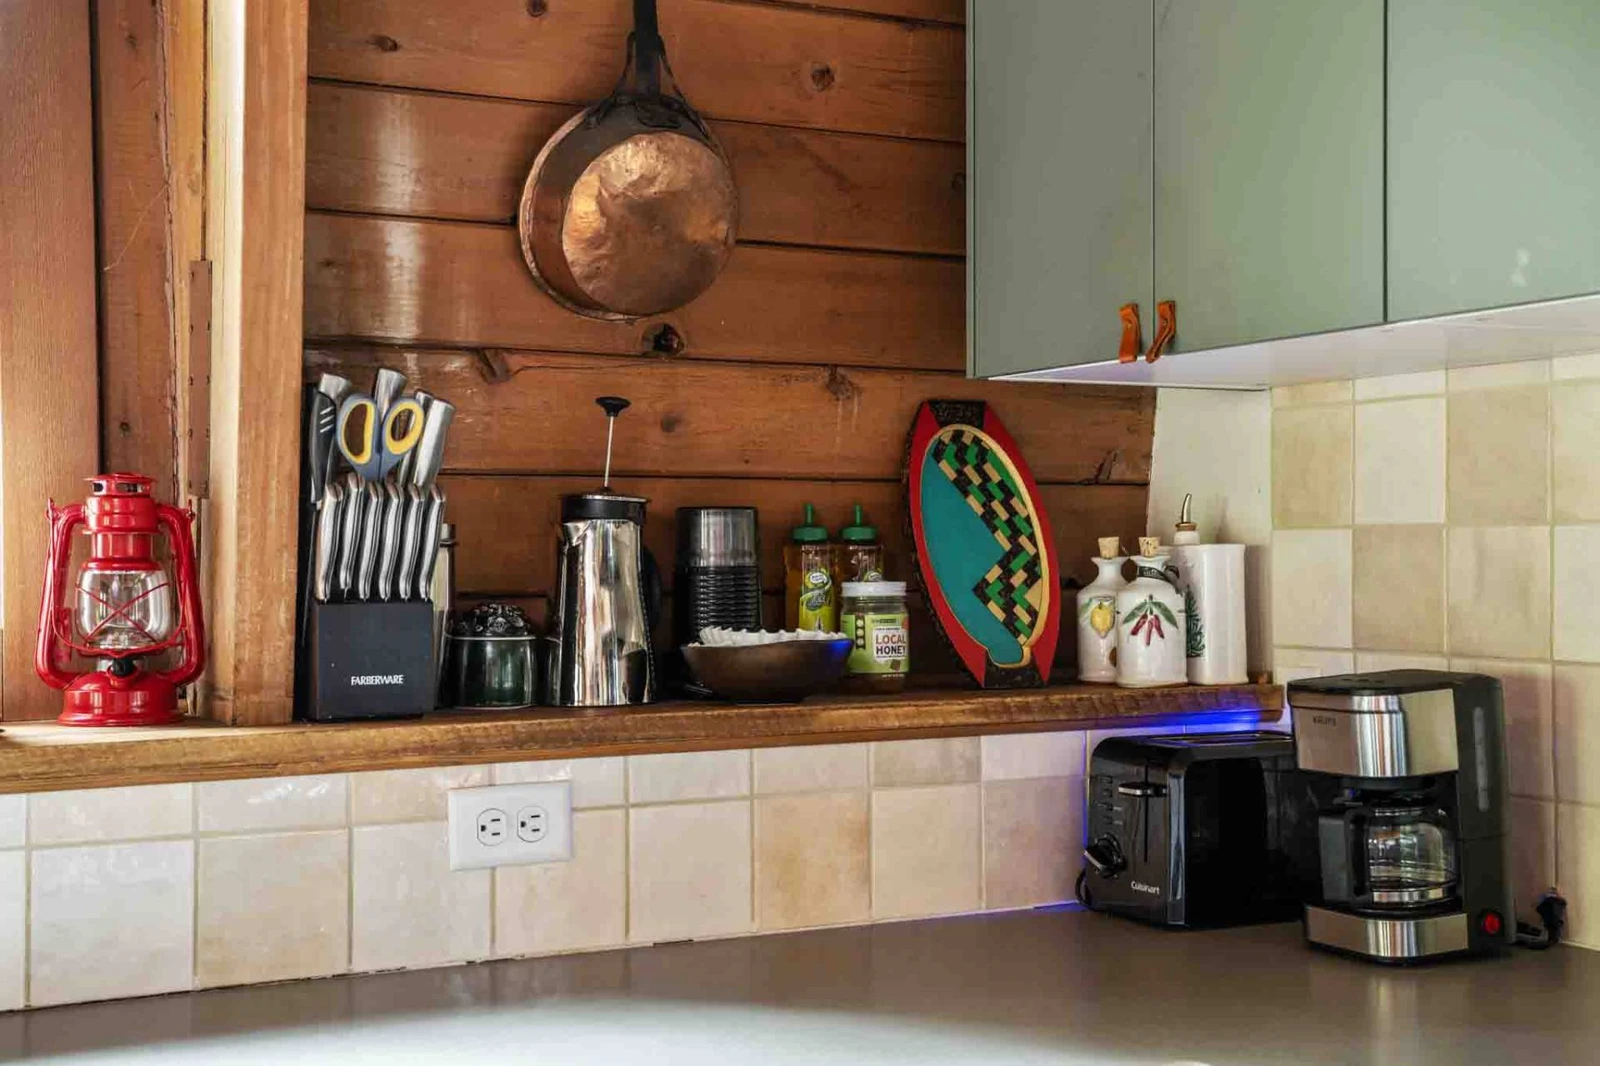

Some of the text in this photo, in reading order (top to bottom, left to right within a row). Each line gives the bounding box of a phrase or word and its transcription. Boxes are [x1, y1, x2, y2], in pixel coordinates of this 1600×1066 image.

[875, 633, 907, 645] LOCAL
[875, 645, 907, 656] HONEY
[350, 674, 405, 687] FARBERWARE
[1130, 880, 1160, 896] Cuisinart
